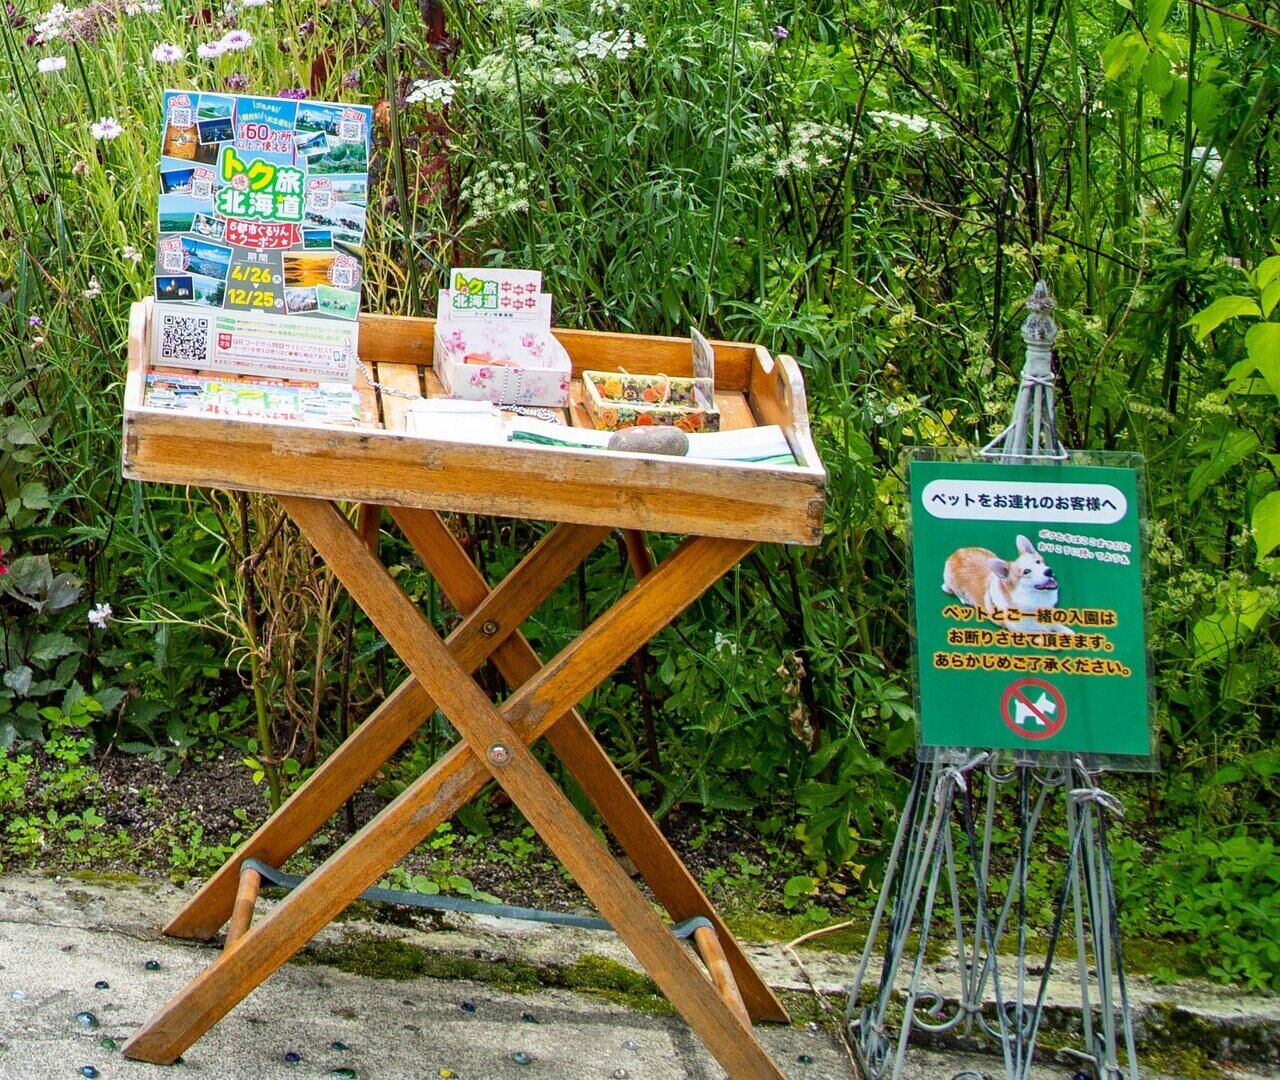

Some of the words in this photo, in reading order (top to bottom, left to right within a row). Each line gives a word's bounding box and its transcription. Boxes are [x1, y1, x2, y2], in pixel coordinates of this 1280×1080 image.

[220, 190, 301, 218] 北海道
[231, 265, 272, 283] 4/26
[228, 288, 274, 308] 12/25
[931, 493, 1117, 512] ペットをお連れのお客様へ
[943, 606, 1116, 626] ペットとご一緒の入園は
[948, 629, 1113, 651] お断りさせて頂きます。
[934, 653, 1130, 676] あらかじめご了承ください。
